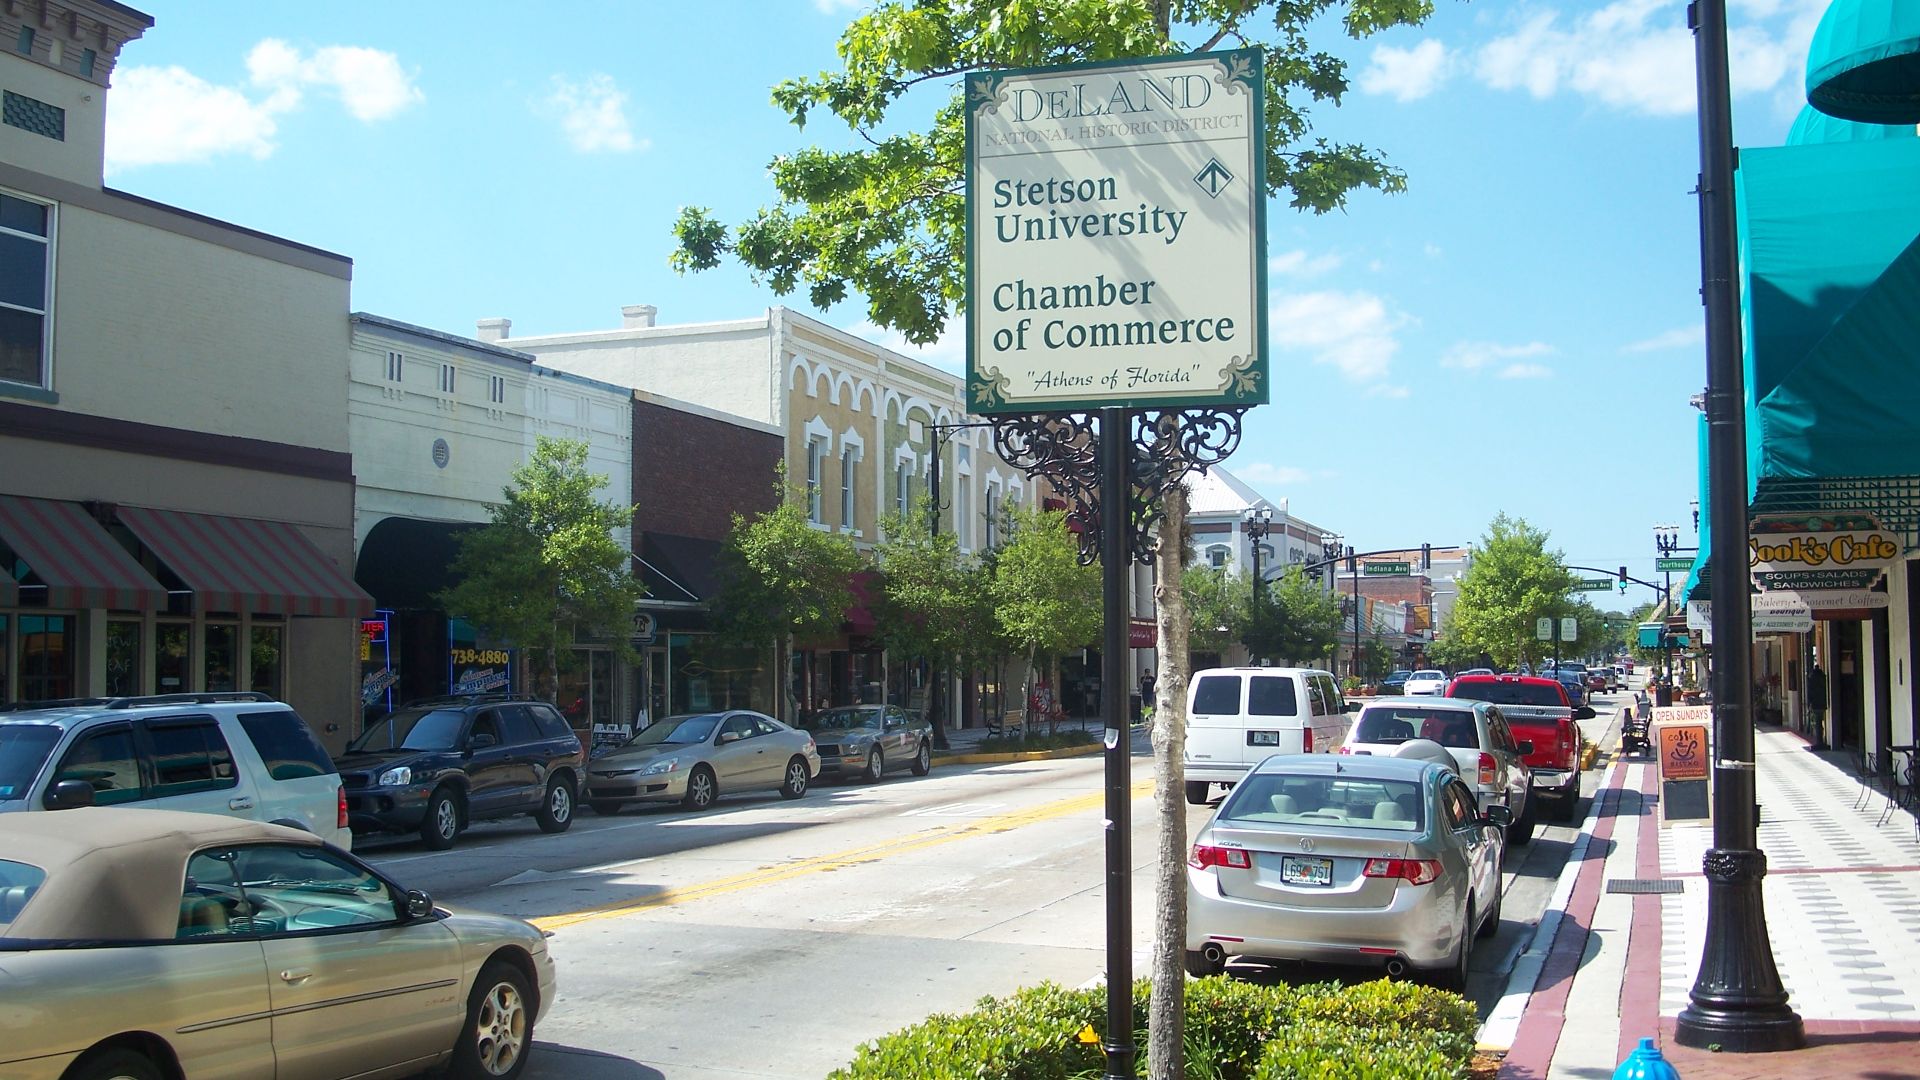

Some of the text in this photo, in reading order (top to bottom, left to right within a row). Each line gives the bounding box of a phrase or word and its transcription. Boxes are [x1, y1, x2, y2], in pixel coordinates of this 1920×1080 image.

[1012, 74, 1212, 123] DELAND
[985, 114, 1243, 147] NATIONAL HISTORIC DISTRICT
[993, 176, 1118, 209] Stetson
[994, 203, 1188, 245] University
[992, 274, 1156, 313] Chamber
[992, 316, 1236, 352] of Commerce
[1100, 369, 1119, 390] of
[1830, 534, 1898, 565] Cafe
[1366, 564, 1408, 572] Indiana Ave
[1658, 561, 1691, 569] Courthouse
[1765, 571, 1868, 580] SOUPS SALADS
[1773, 579, 1861, 590] SANDWICHES
[1753, 594, 1885, 609] Bakery Gourmet Coffees
[451, 649, 509, 664] 738-4880
[1656, 709, 1709, 721] OPEN SUNDAYS
